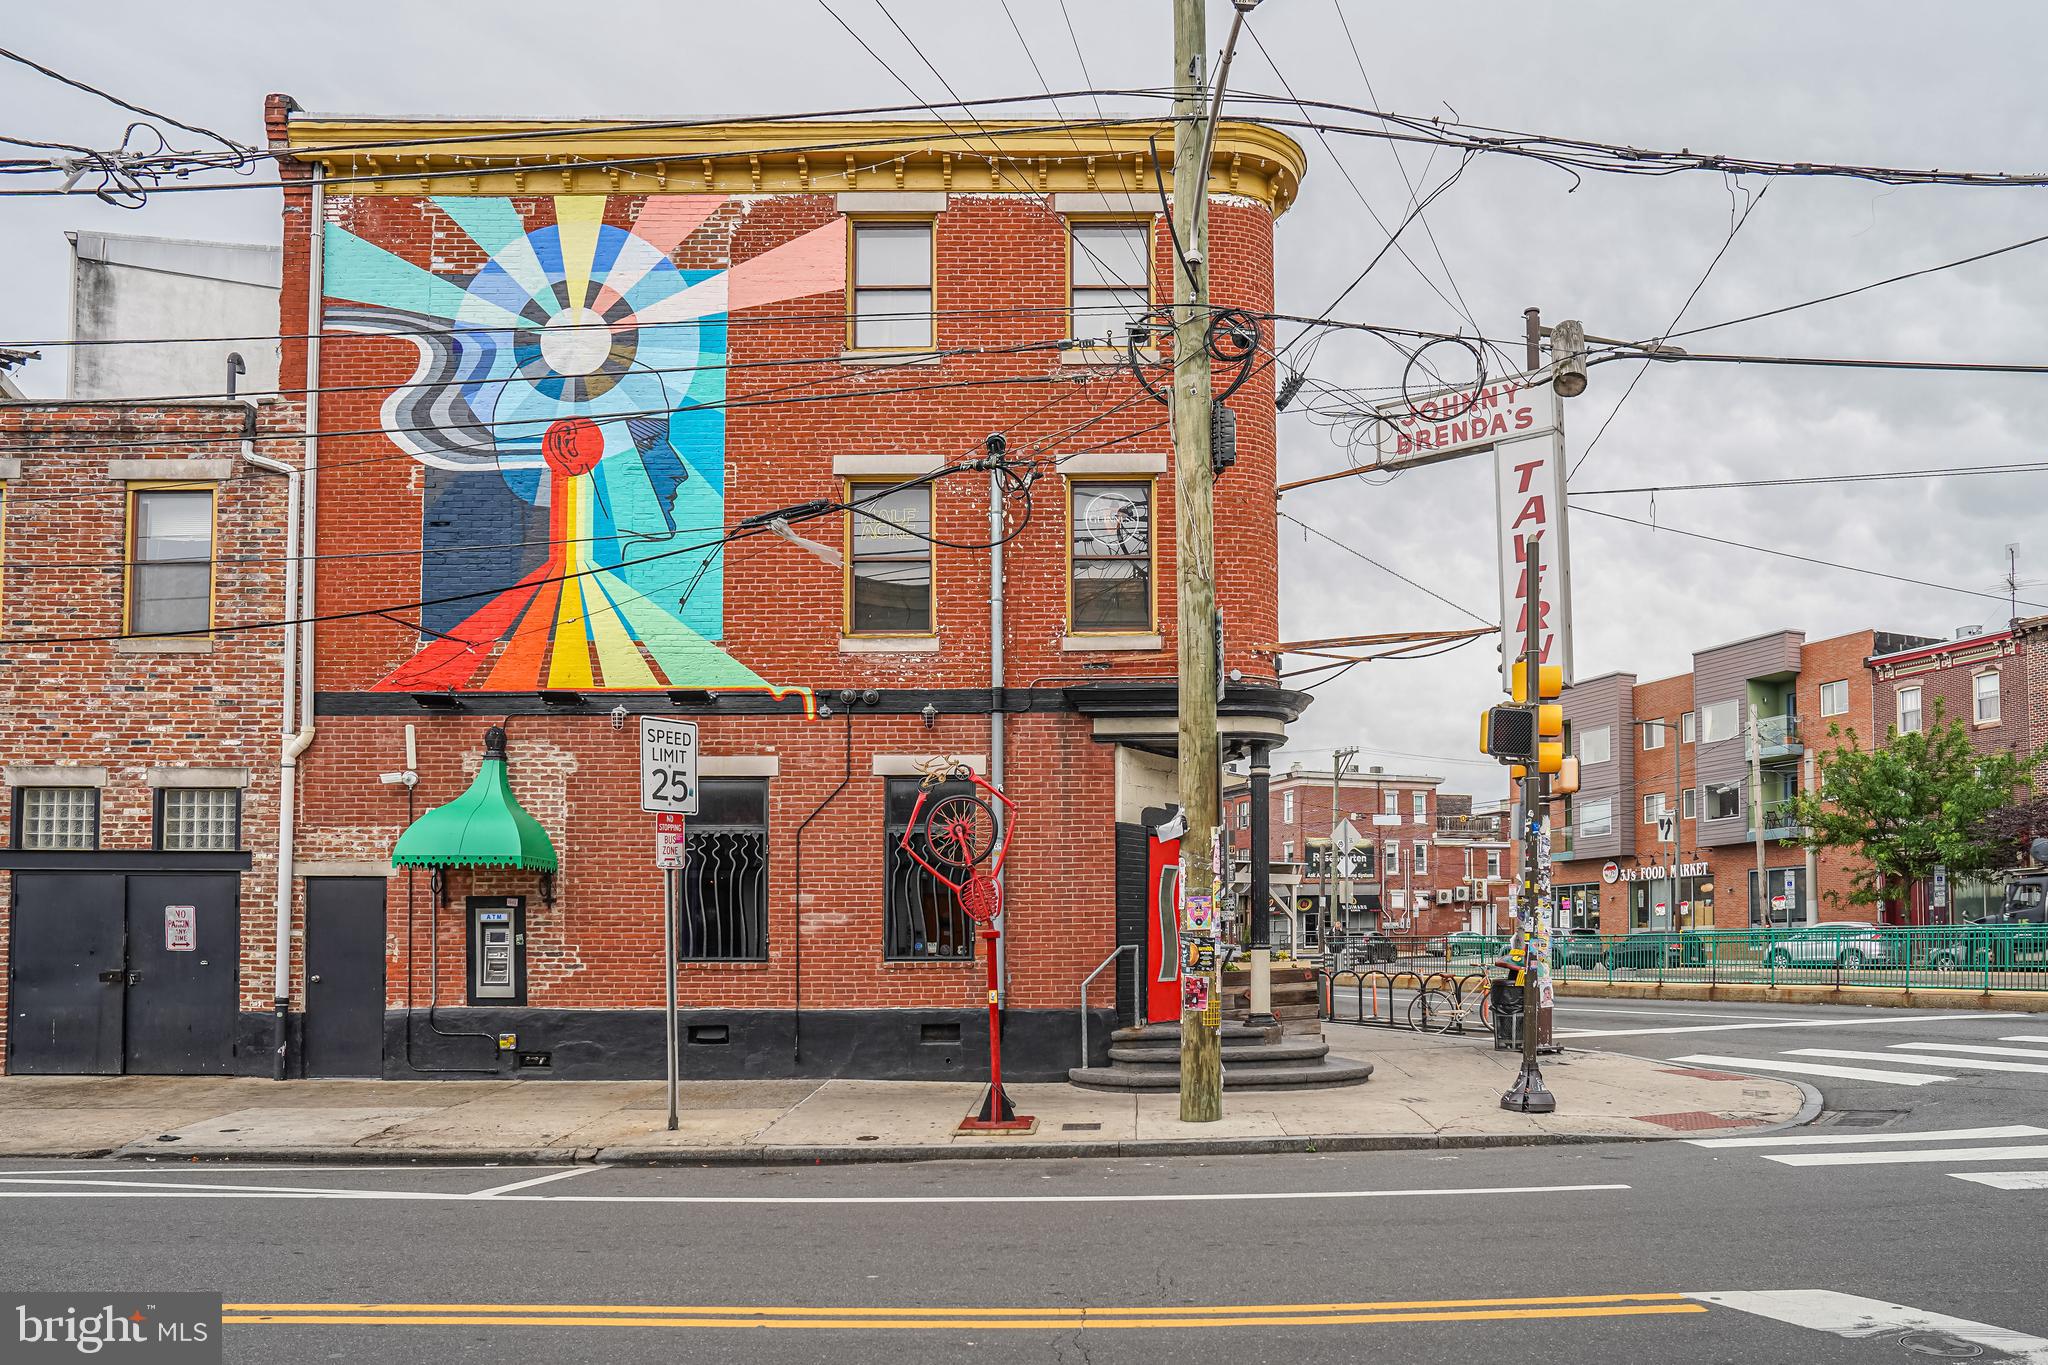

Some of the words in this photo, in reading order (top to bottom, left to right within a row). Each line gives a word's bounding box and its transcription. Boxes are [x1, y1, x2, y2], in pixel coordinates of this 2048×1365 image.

[1400, 381, 1520, 427] JOHNNY
[1396, 407, 1534, 456] BRENDA'S
[647, 728, 692, 747] SPEED
[652, 747, 687, 764] LIMIT
[652, 768, 688, 803] 25
[666, 815, 674, 823] NO
[659, 823, 682, 832] STOPPING
[664, 835, 677, 845] BUS
[663, 846, 679, 856] ZONE
[1640, 866, 1665, 880] FOOD
[175, 909, 187, 919] NO
